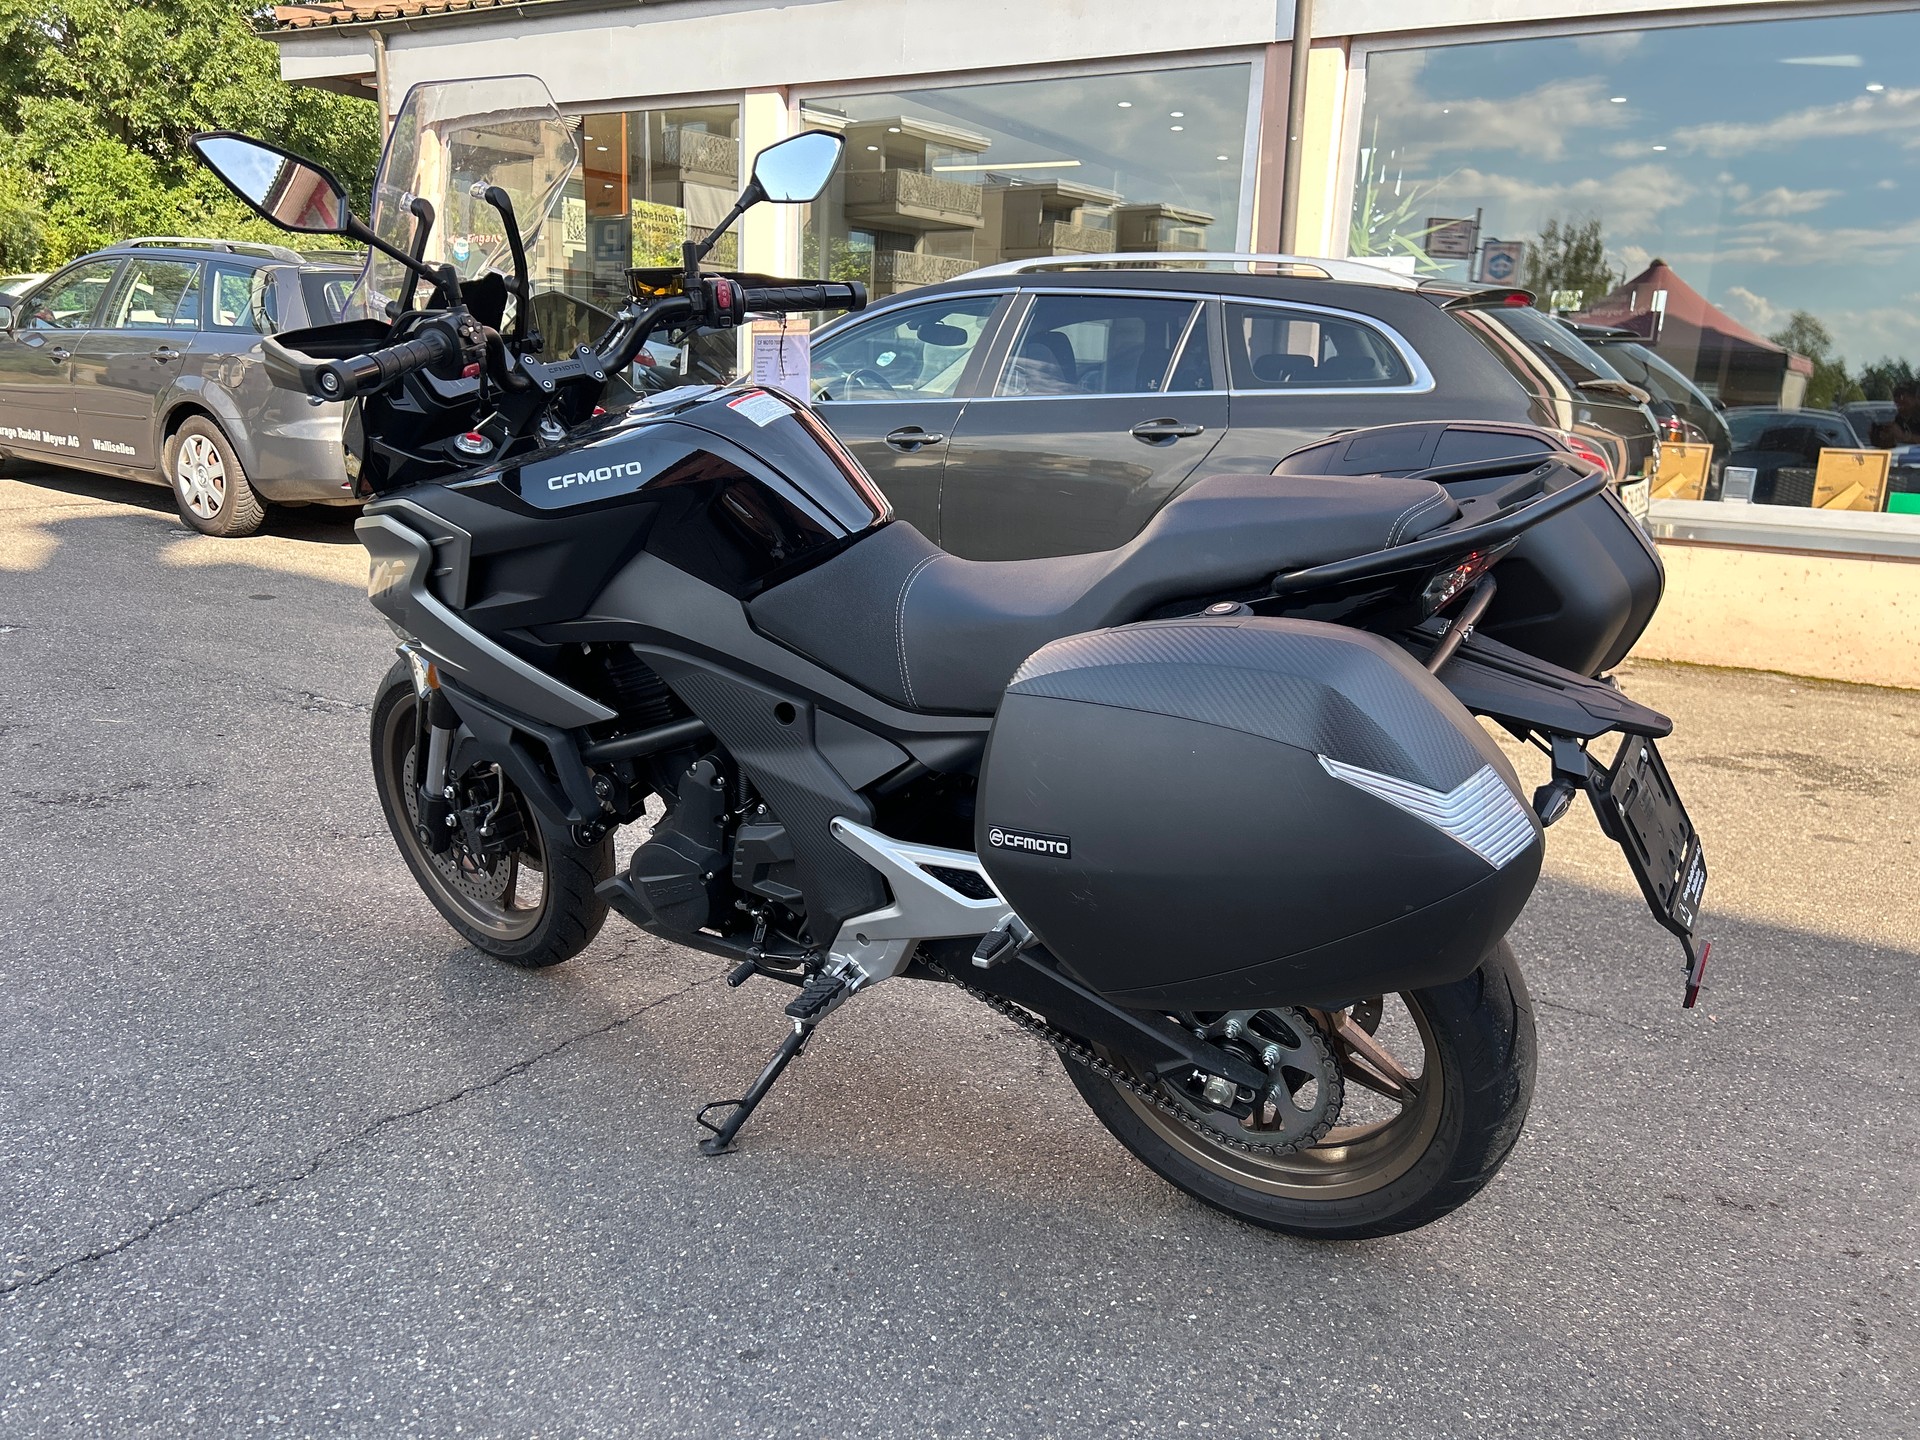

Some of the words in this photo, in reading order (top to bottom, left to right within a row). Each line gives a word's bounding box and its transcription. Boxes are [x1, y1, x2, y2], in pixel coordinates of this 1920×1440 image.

[17, 427, 41, 442] Rudolf
[42, 431, 67, 447] Meyer
[67, 435, 80, 448] AG
[92, 438, 136, 456] Wallisellen
[547, 461, 642, 491] CFMOTO
[1004, 833, 1068, 855] CFMOTO
